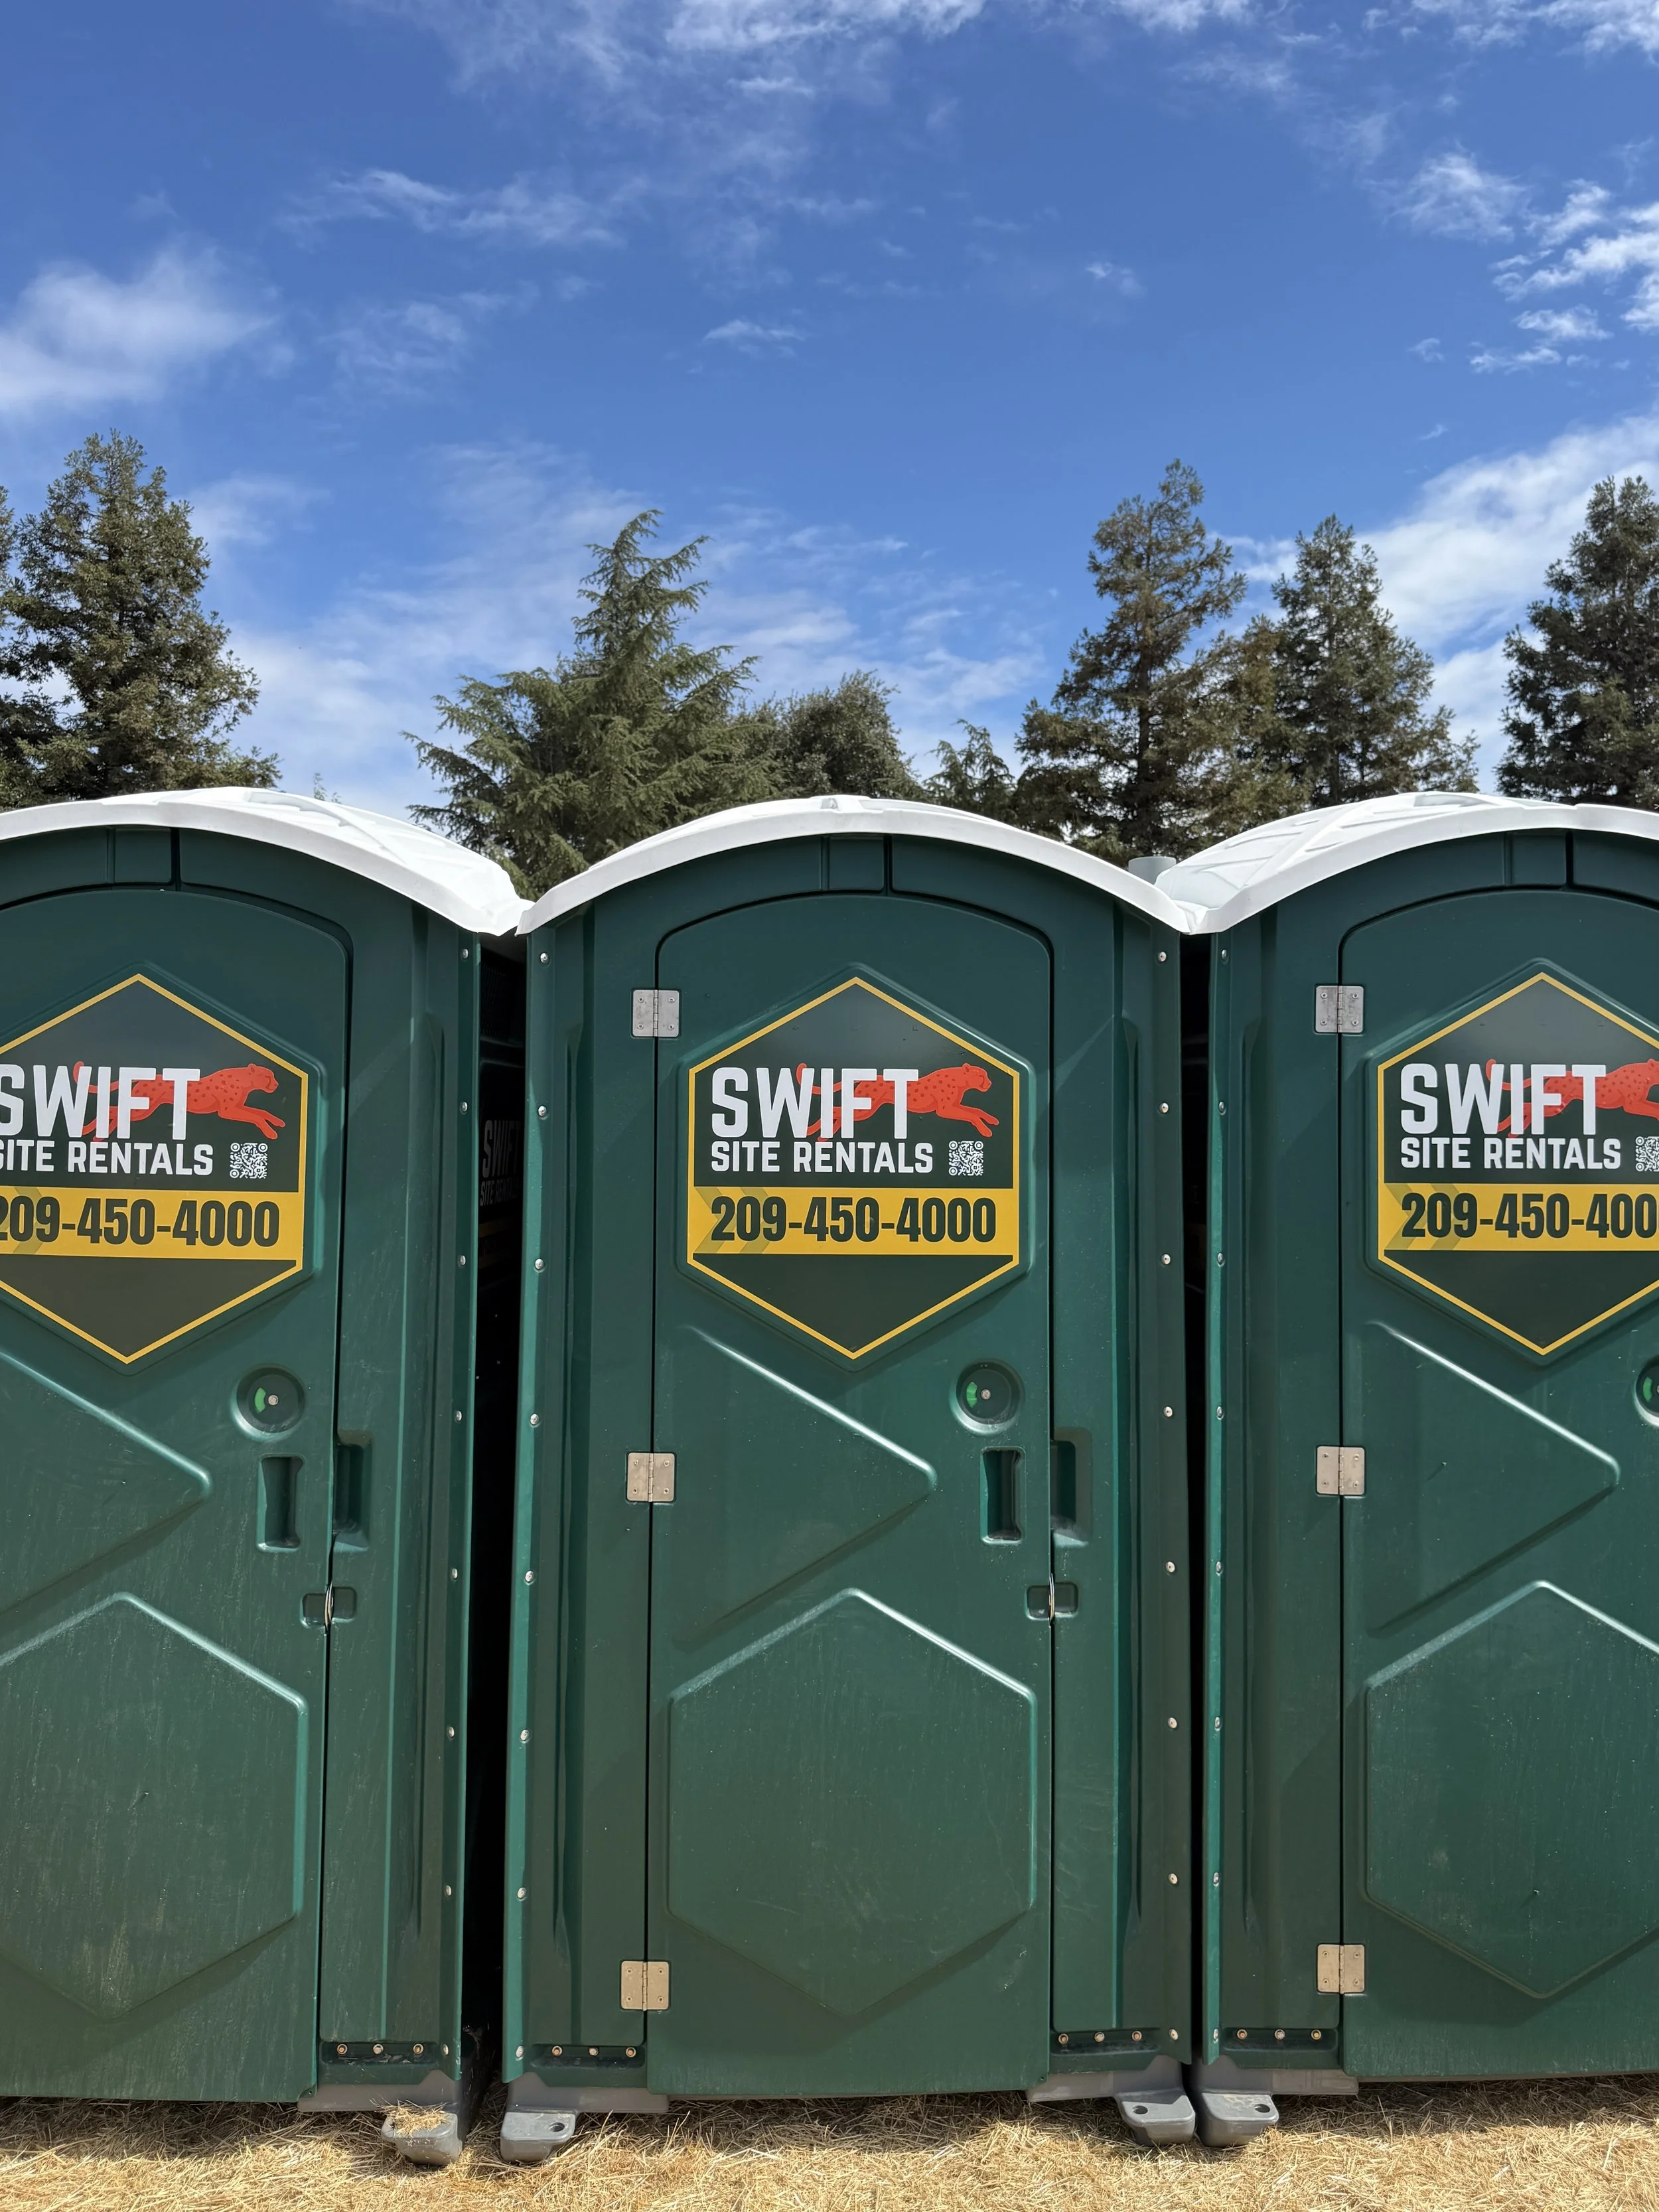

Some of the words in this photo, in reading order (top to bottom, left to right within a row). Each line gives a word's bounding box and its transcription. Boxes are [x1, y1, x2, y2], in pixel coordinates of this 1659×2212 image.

[0, 1063, 201, 1141] SWIFT
[711, 1067, 919, 1140] SWIFT
[1400, 1063, 1607, 1136] SWIFT
[0, 1139, 55, 1172] ITE
[68, 1140, 214, 1175] RENTALS
[711, 1140, 780, 1172] SITE
[793, 1141, 933, 1173] RENTALS
[1401, 1137, 1471, 1169] SITE
[1484, 1138, 1621, 1169] RENTALS
[711, 1195, 996, 1243] 209-450-4000
[1401, 1192, 1659, 1239] 209-450-400
